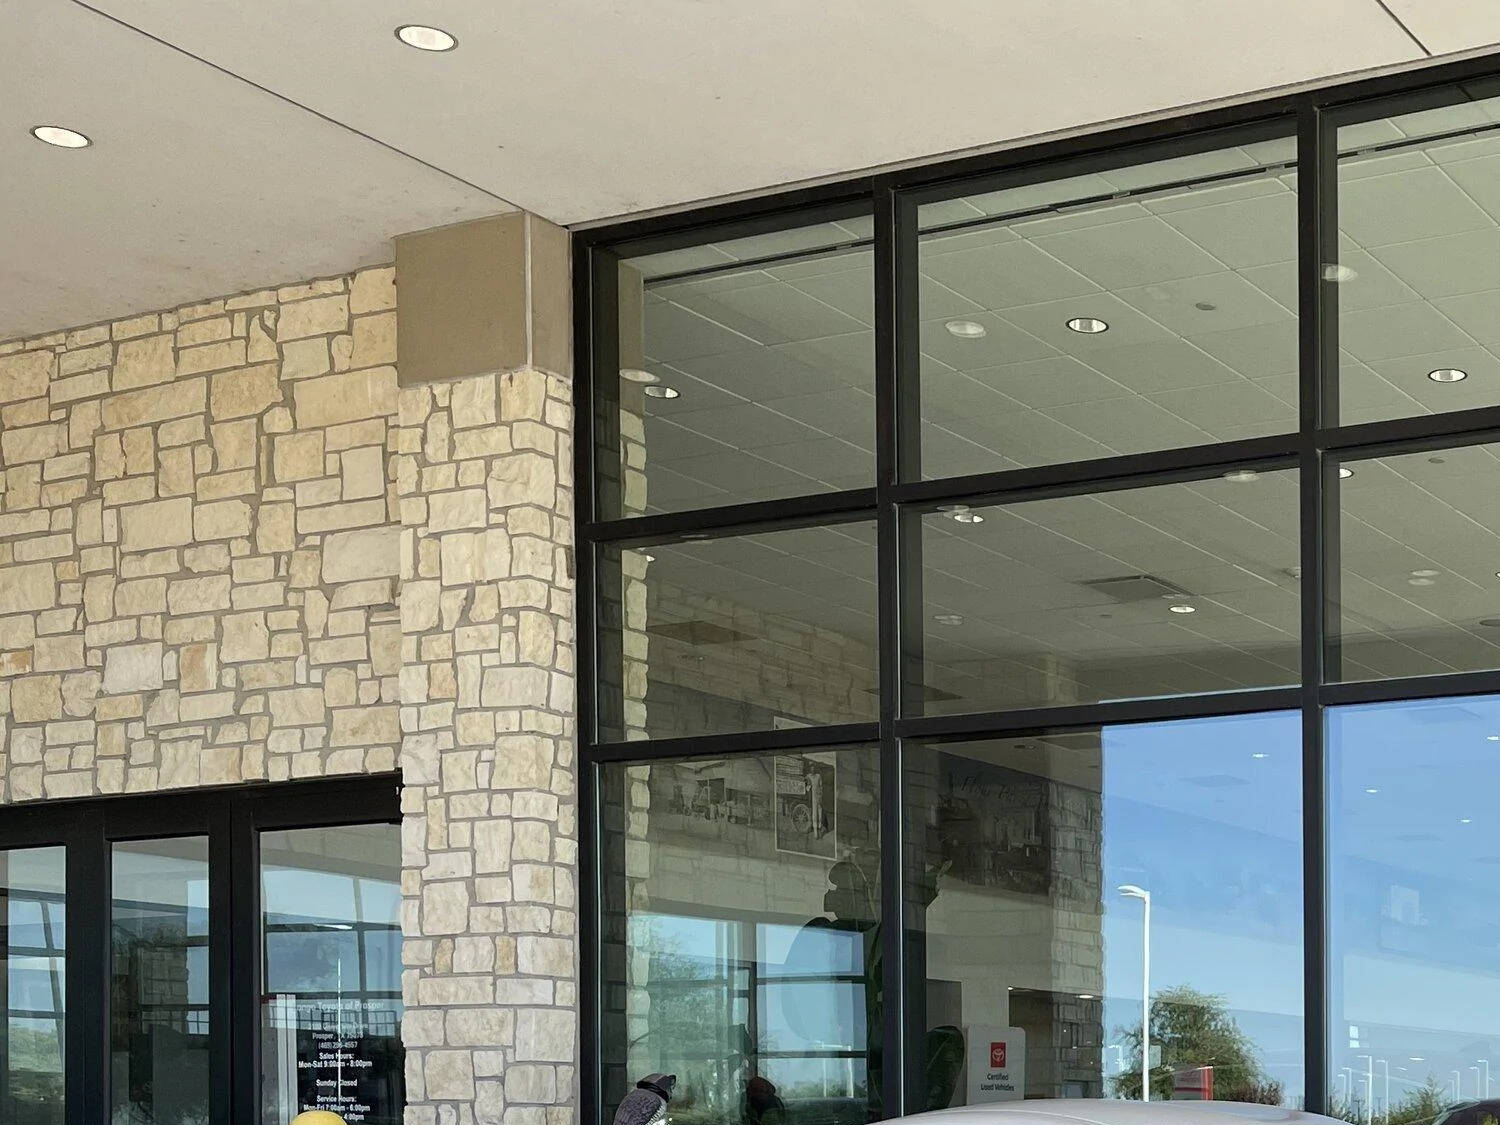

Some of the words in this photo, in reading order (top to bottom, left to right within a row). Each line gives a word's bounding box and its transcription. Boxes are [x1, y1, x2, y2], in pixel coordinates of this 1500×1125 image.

[355, 1000, 384, 1010] Prosper
[319, 1052, 334, 1060] Sales
[335, 1052, 354, 1060] Hours:
[298, 1060, 323, 1068] Mon-Sat
[323, 1060, 345, 1068] 9:00am
[349, 1060, 372, 1068] 8:00pm
[986, 1072, 1009, 1081] Certified
[316, 1079, 337, 1088] Sunday
[980, 1083, 994, 1091] Used
[994, 1083, 1015, 1092] Vehicles
[343, 1113, 365, 1121] 4:00pm
